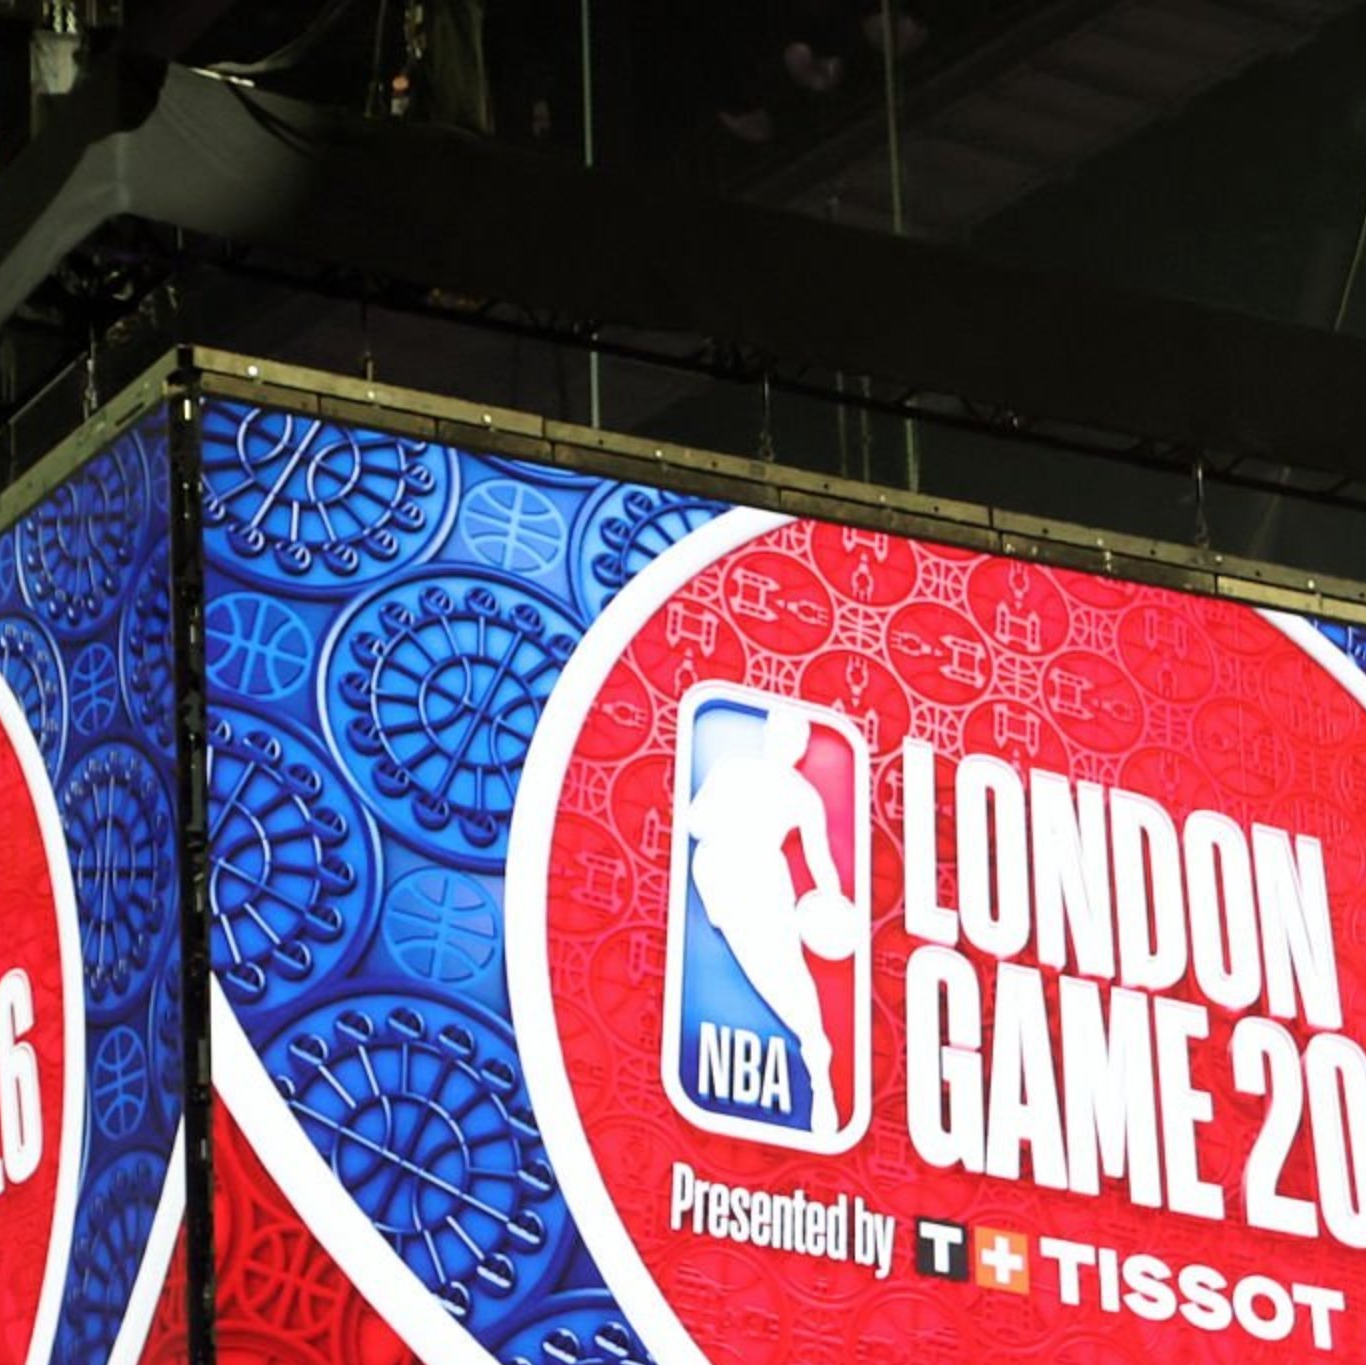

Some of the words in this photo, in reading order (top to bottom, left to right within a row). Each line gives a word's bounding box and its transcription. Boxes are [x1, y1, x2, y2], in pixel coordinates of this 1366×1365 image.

[903, 735, 1344, 1030] LONDON
[698, 1021, 792, 1114] NBA
[905, 945, 1225, 1220] GAME
[670, 1162, 848, 1261] Presented
[854, 1197, 895, 1279] by
[1039, 1236, 1345, 1350] TISSOT
